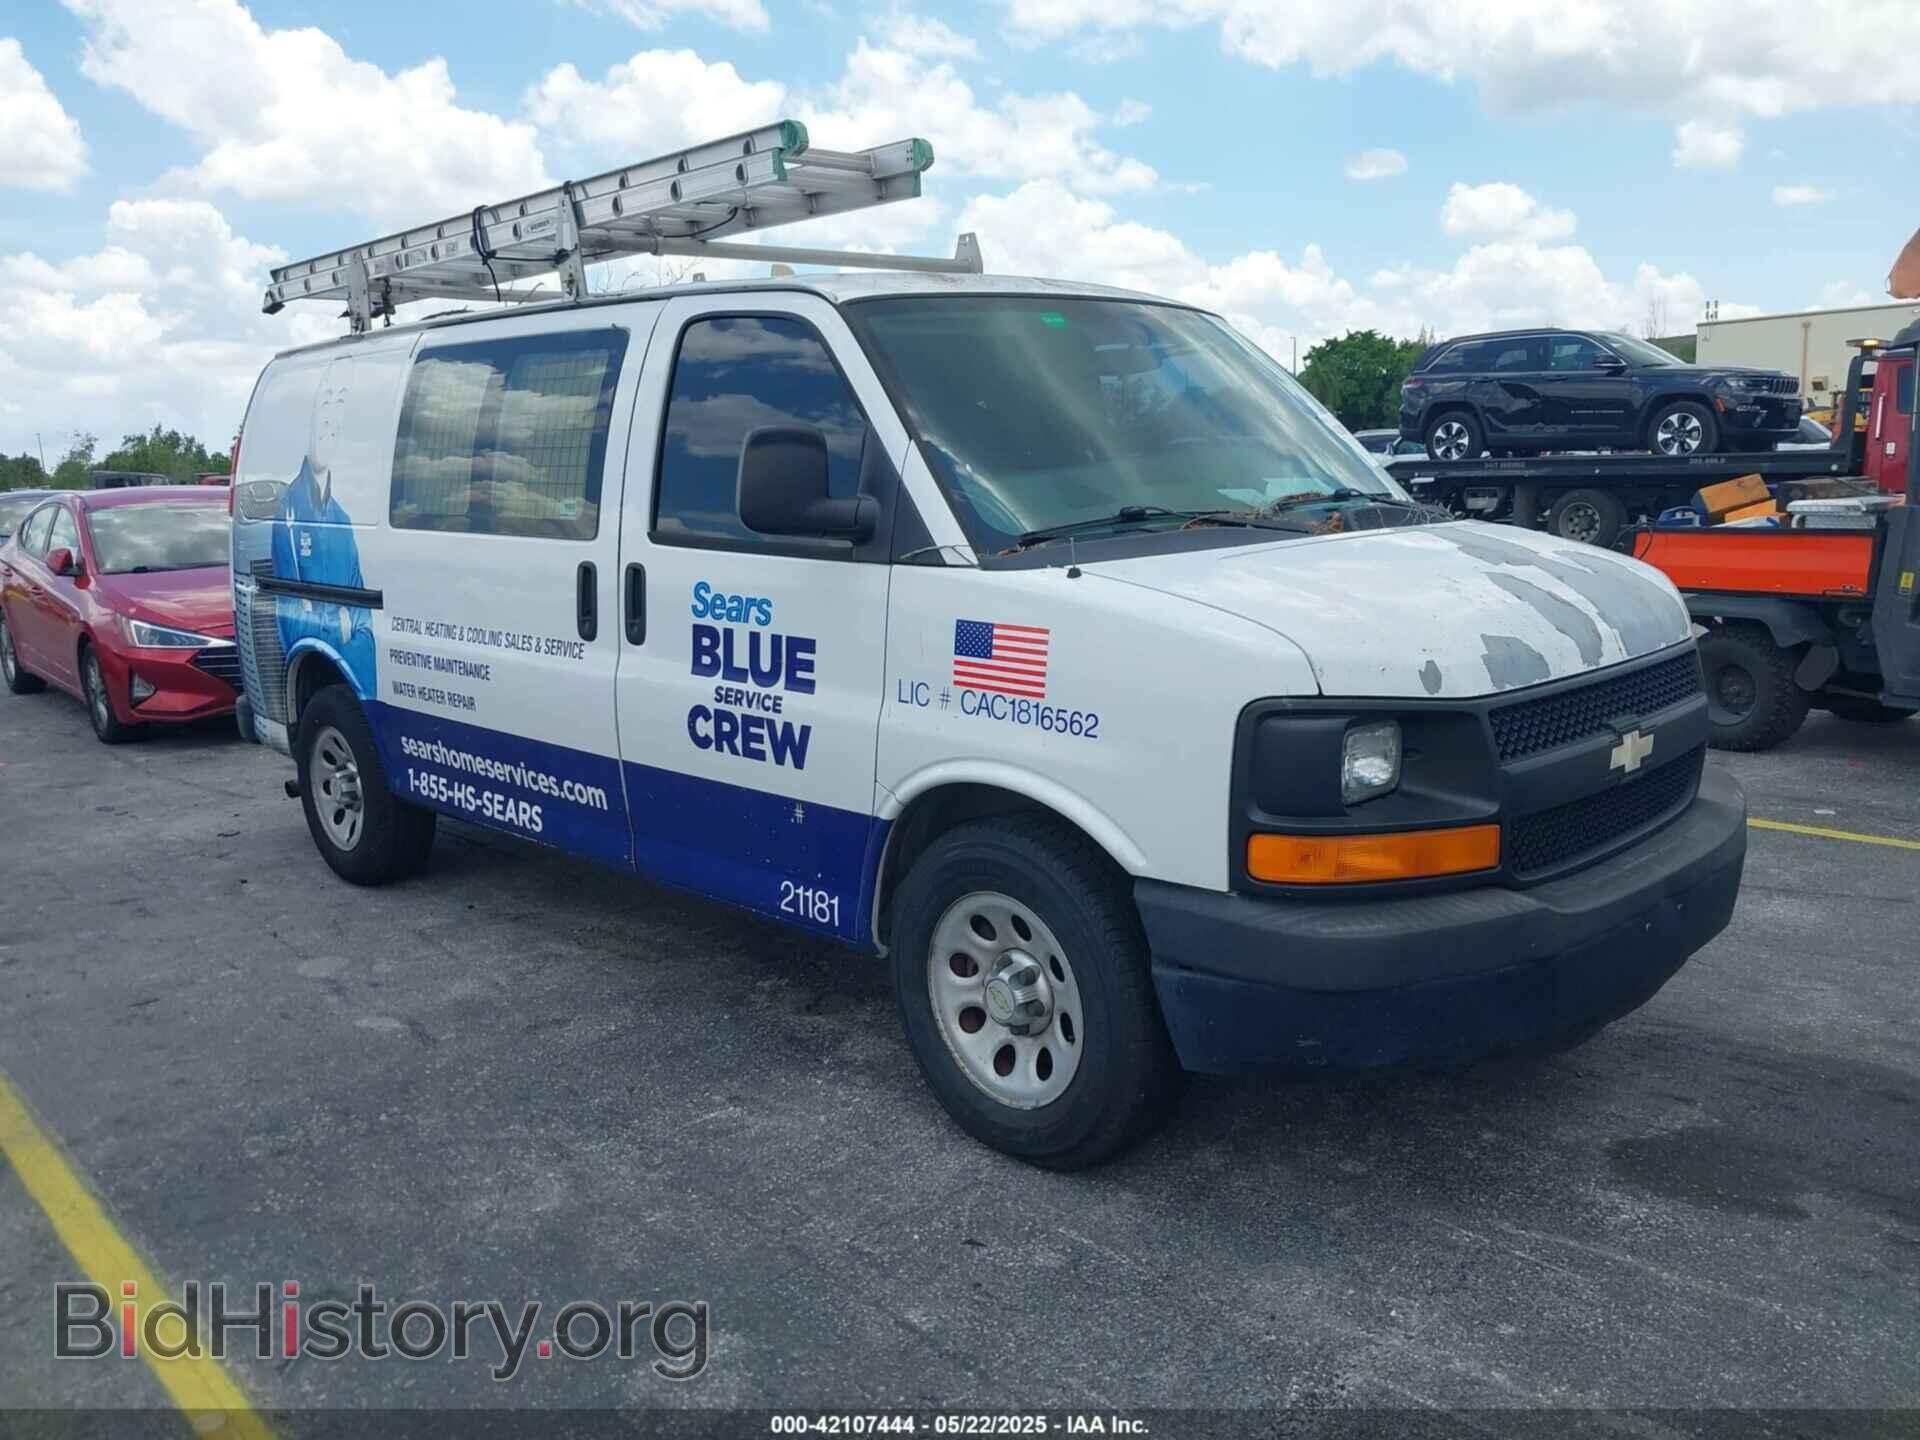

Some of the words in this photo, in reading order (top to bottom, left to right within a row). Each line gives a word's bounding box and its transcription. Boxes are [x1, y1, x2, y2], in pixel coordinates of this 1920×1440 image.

[691, 581, 773, 627] Sears
[392, 616, 423, 635] CENTRAL
[424, 621, 457, 640] HEATING
[458, 626, 465, 641] &
[466, 627, 503, 648] COOLING
[504, 632, 533, 652] SALES
[535, 637, 542, 653] &
[544, 637, 585, 660] SERVICE
[691, 623, 817, 695] BLUE
[389, 648, 432, 670] PREVENTIVE
[433, 656, 491, 681] MAINTENANCE
[392, 680, 416, 698] WATER
[417, 686, 446, 704] HEATER
[447, 691, 476, 712] REPAIR
[714, 686, 783, 713] SERVICE
[897, 679, 930, 707] LIC
[939, 686, 951, 710] #
[960, 689, 1099, 738] CAC1816562
[688, 704, 812, 770] CREW
[401, 736, 608, 810] searshomeservices.com
[408, 768, 543, 832] 1-855-HS-SEARS
[780, 880, 839, 927] 21181
